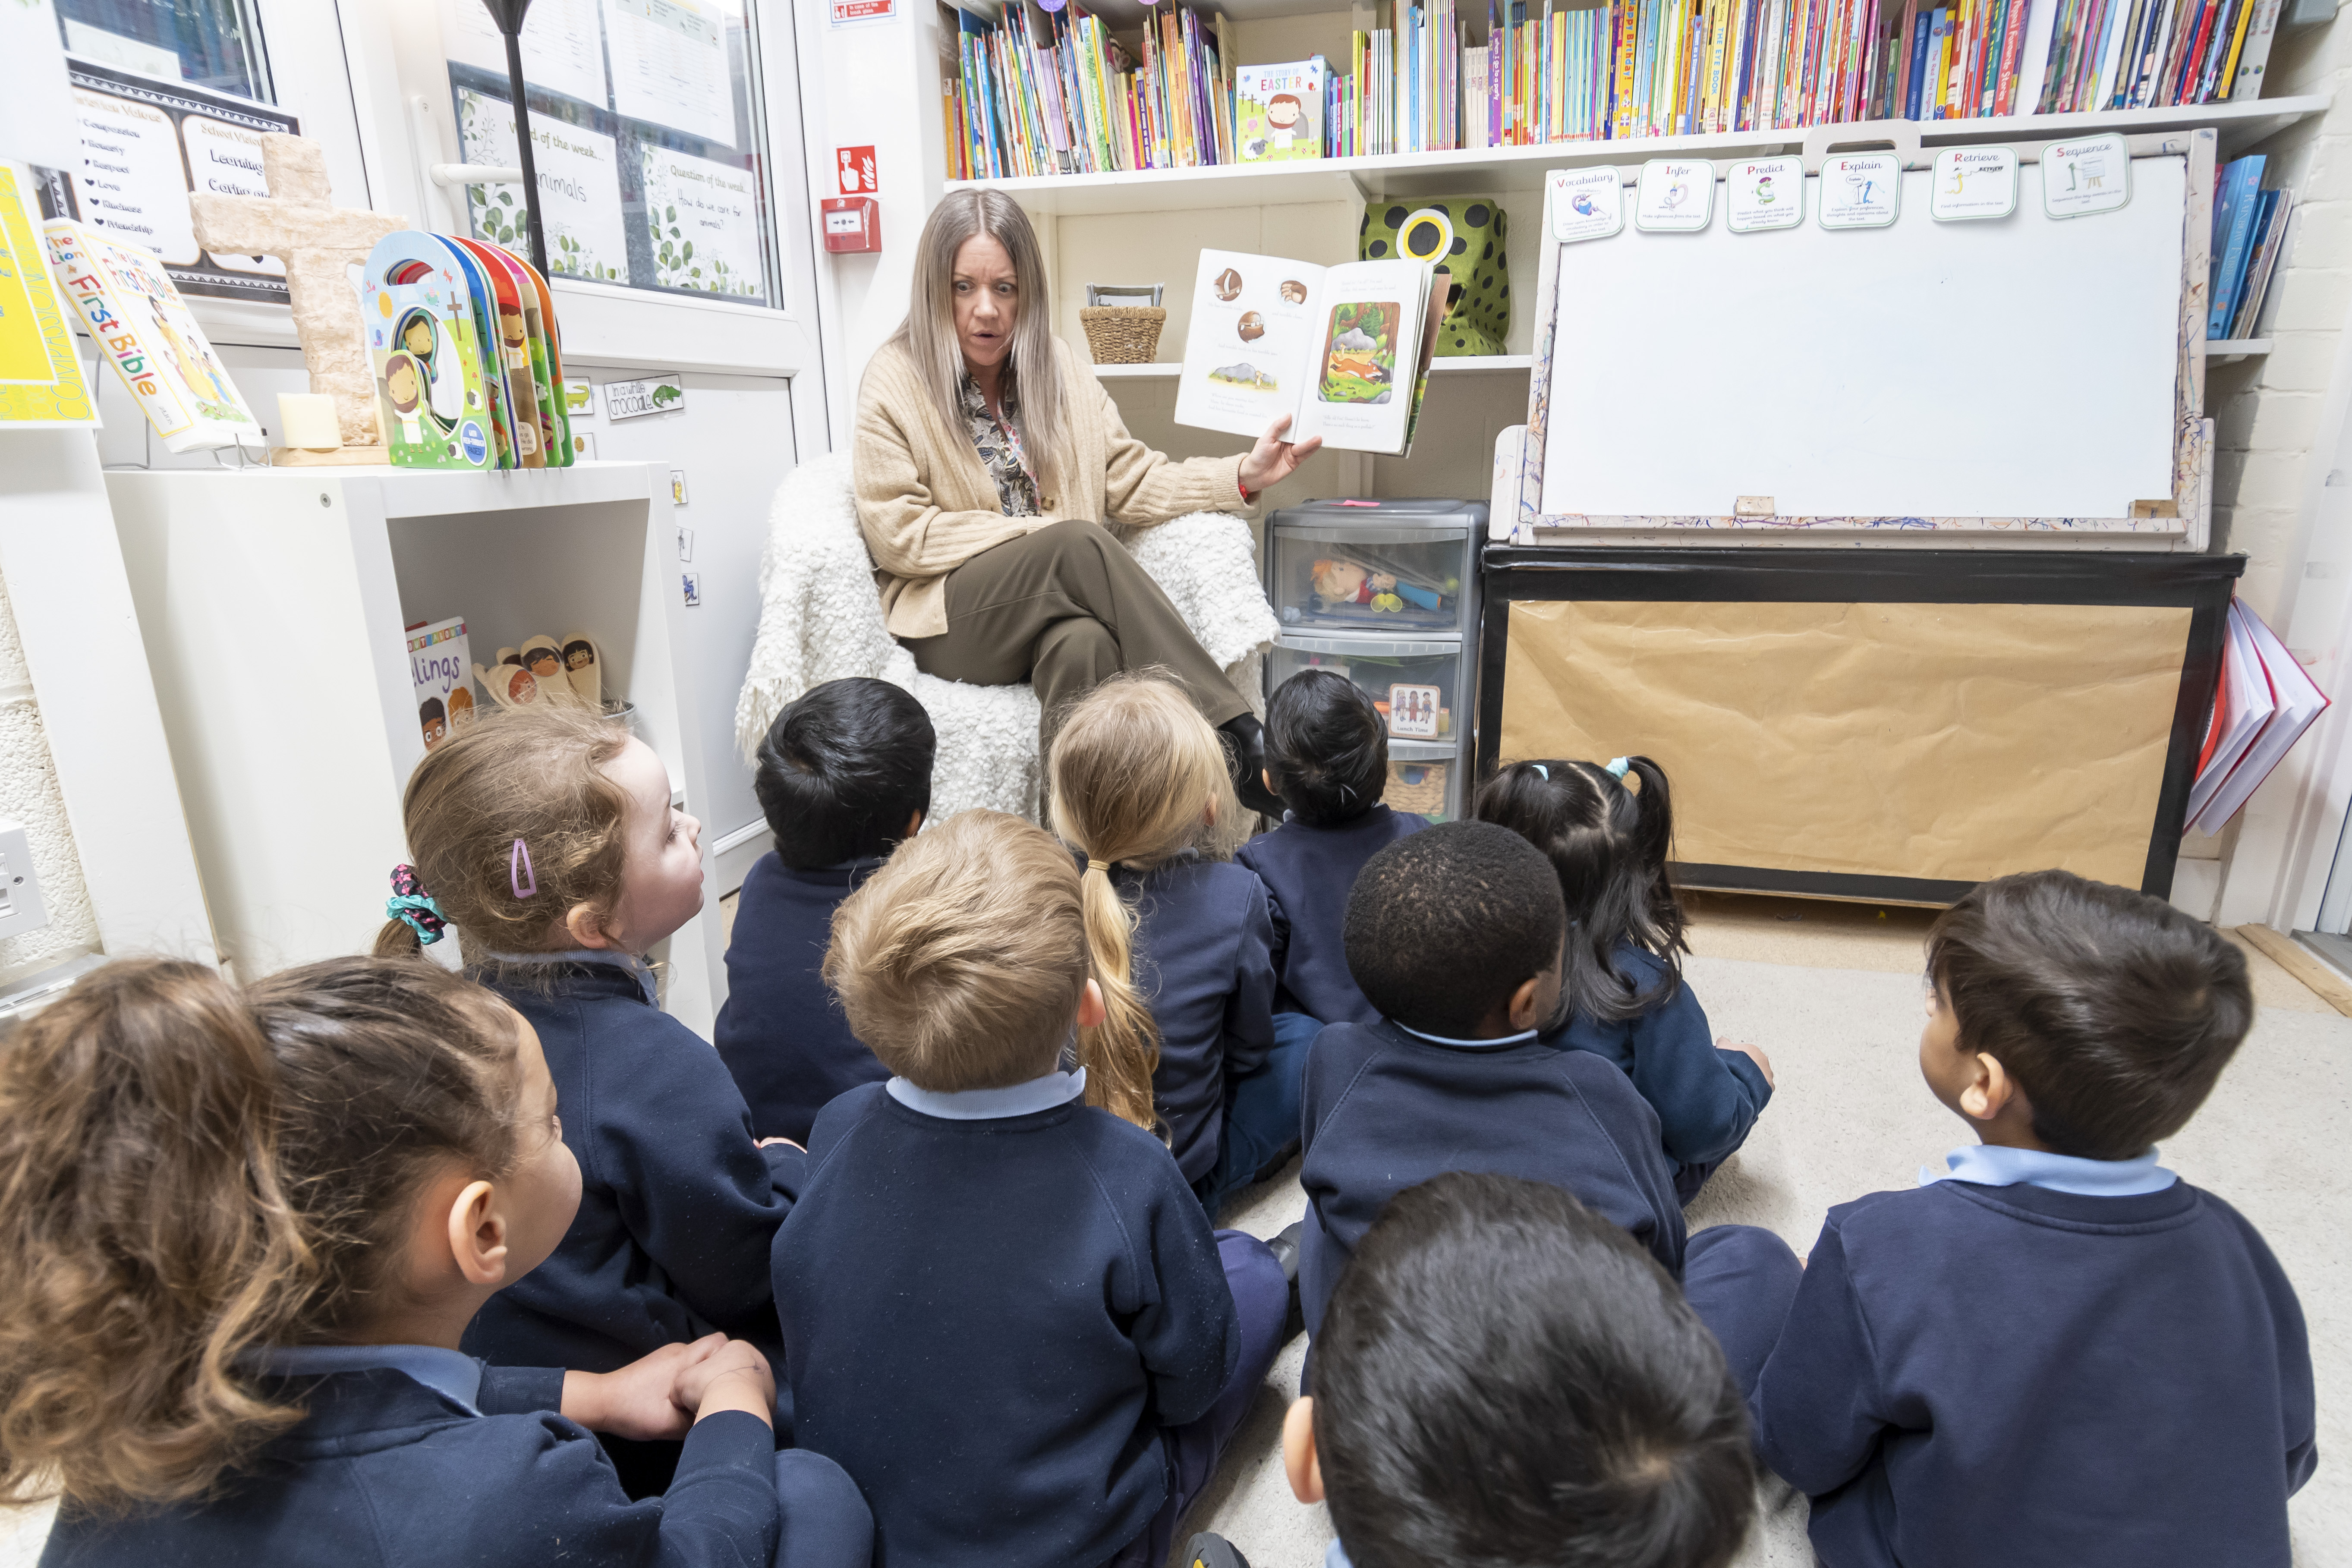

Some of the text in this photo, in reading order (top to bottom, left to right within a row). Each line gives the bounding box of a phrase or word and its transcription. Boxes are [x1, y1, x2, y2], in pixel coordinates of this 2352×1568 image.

[1623, 0, 1637, 80] Happy Birthday!
[2003, 30, 2018, 70] Favourite
[1261, 76, 1301, 91] EASTER
[1711, 69, 1719, 95] BOOK
[1998, 71, 2010, 101] Stories
[201, 123, 233, 140] School
[541, 132, 550, 149] of
[553, 135, 569, 150] the
[1955, 153, 2000, 162] Retrieve
[2057, 144, 2113, 157] Sequence
[210, 149, 264, 176] Learning
[1748, 164, 1785, 175] Predict
[1841, 161, 1883, 173] Explain
[671, 165, 705, 183] Question
[707, 174, 713, 189] of
[715, 176, 726, 188] the
[1666, 166, 1691, 177] Infer
[98, 180, 120, 191] Love
[1557, 175, 1614, 187] Vocabulary
[102, 200, 142, 213] Kindness
[678, 188, 692, 207] How
[696, 197, 704, 208] do
[718, 206, 729, 214] care
[107, 220, 153, 235] Friendship
[699, 219, 724, 230] animals?
[50, 251, 84, 265] Lion
[107, 246, 126, 262] The
[102, 258, 177, 301] First Bible
[69, 274, 157, 396] First Bible
[413, 656, 460, 693] lings
